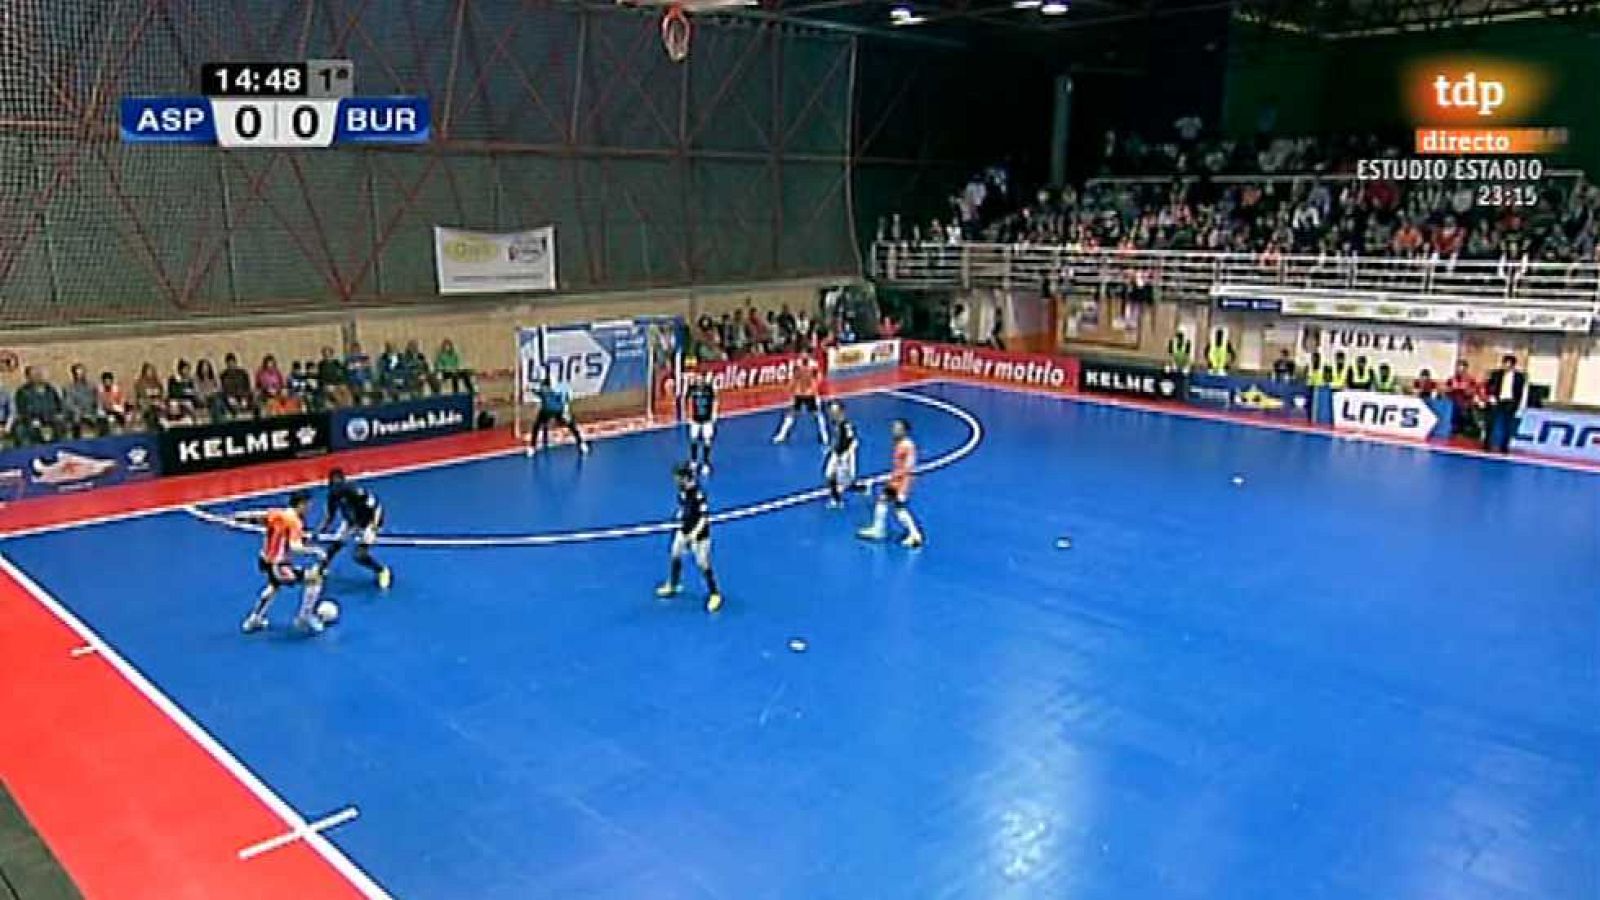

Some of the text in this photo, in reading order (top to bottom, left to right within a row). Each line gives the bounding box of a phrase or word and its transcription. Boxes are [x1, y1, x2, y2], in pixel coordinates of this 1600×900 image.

[1328, 328, 1414, 352] TUDELA
[923, 346, 941, 367] Tu
[943, 350, 993, 377] taller
[1085, 369, 1156, 394] KELME
[178, 429, 290, 463] KELME
